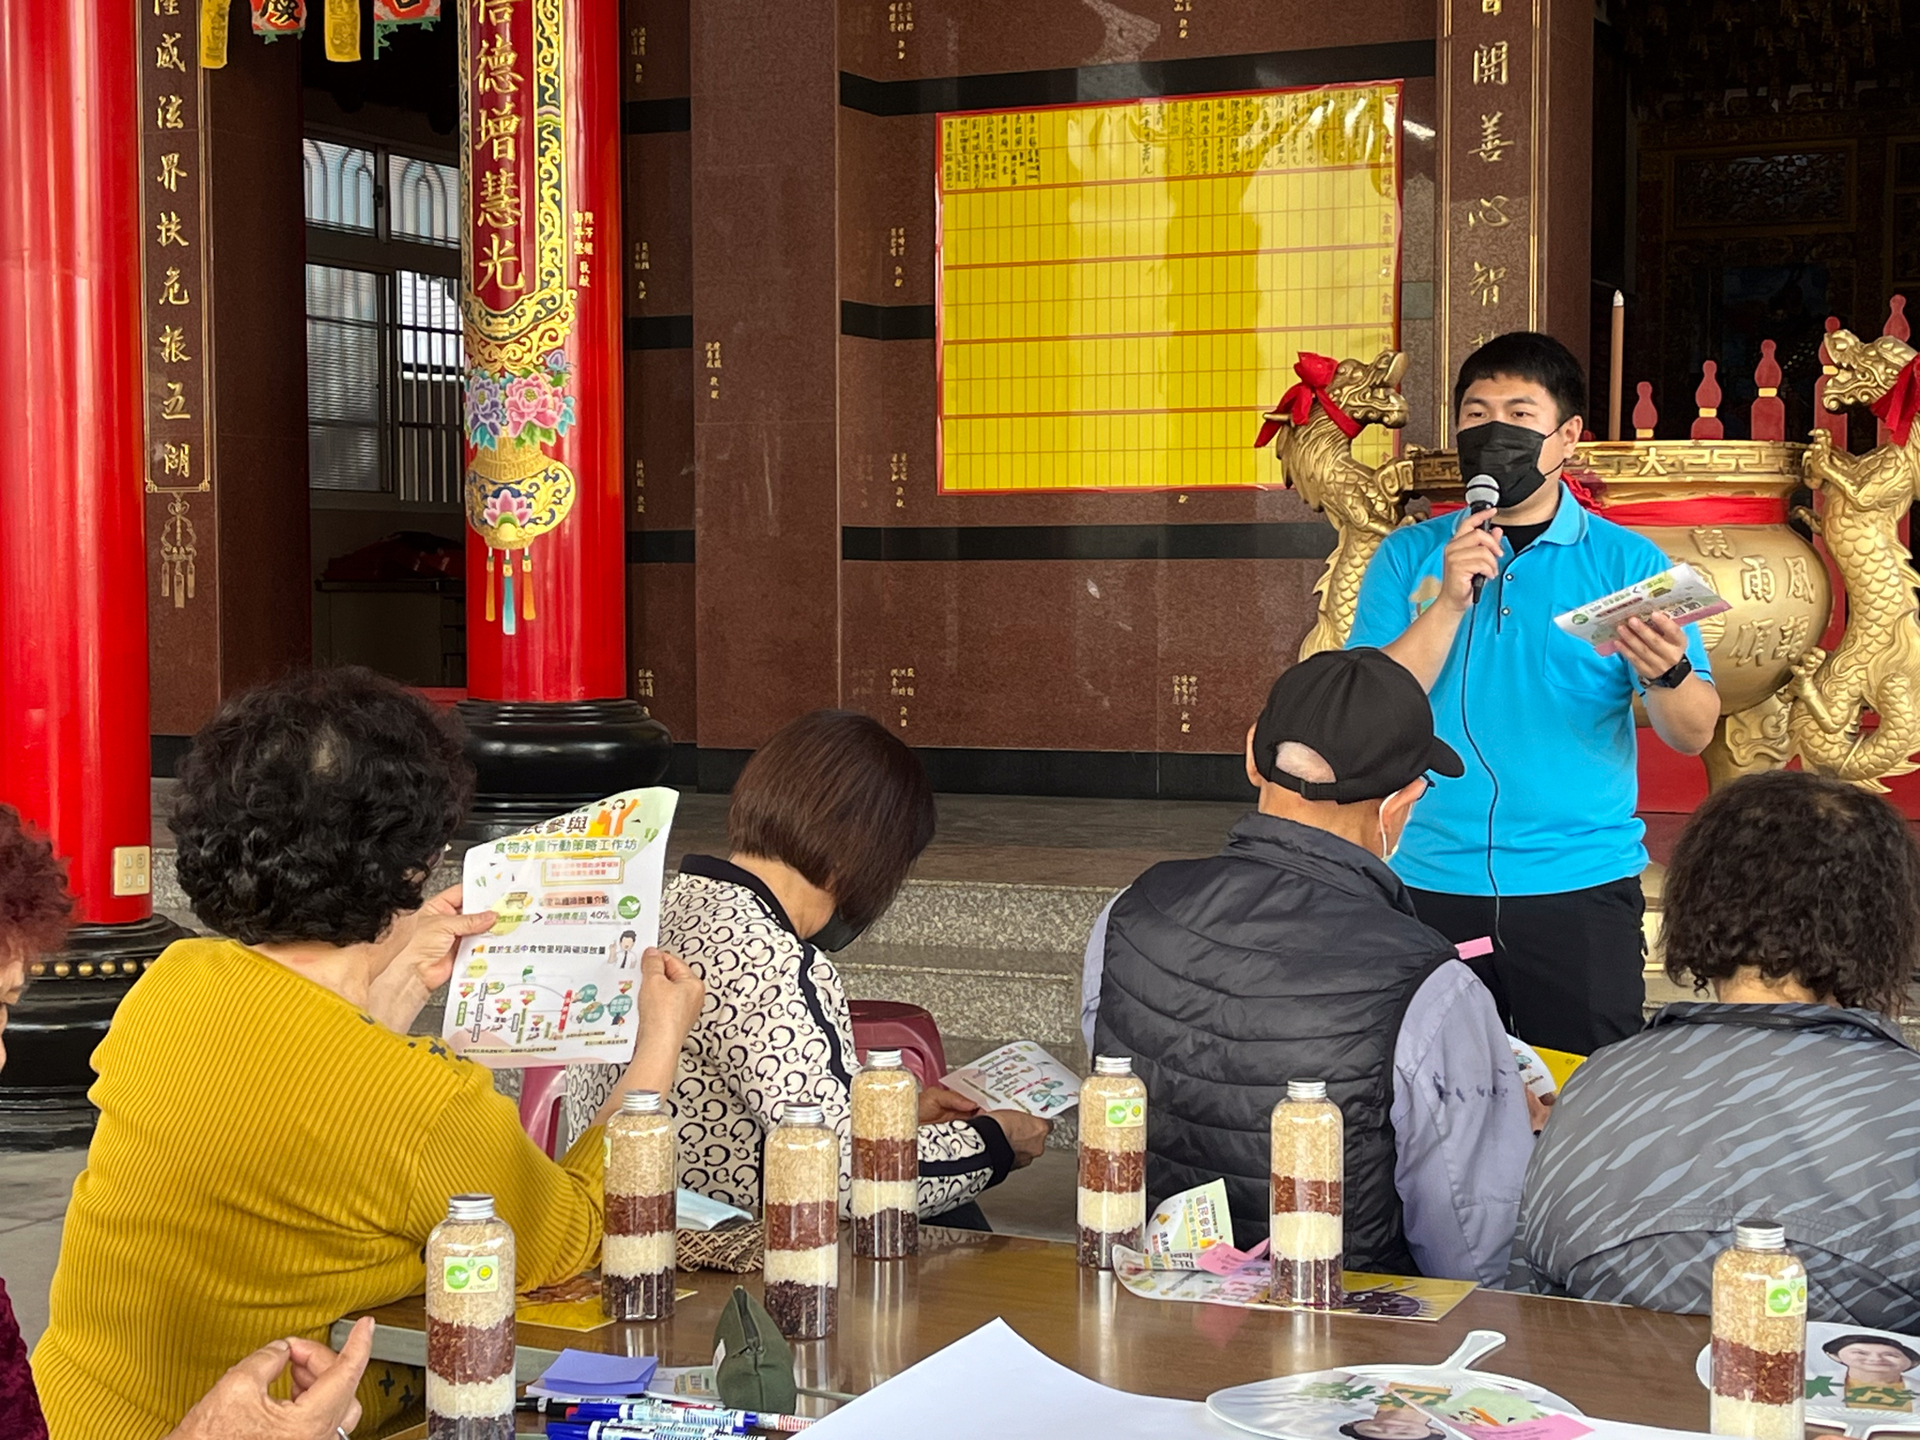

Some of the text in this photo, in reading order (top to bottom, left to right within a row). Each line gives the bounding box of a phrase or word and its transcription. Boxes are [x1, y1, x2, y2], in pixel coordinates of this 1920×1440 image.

[1468, 0, 1514, 346] 開善心智
[1639, 447, 1667, 475] 大
[590, 910, 611, 920] 40%
